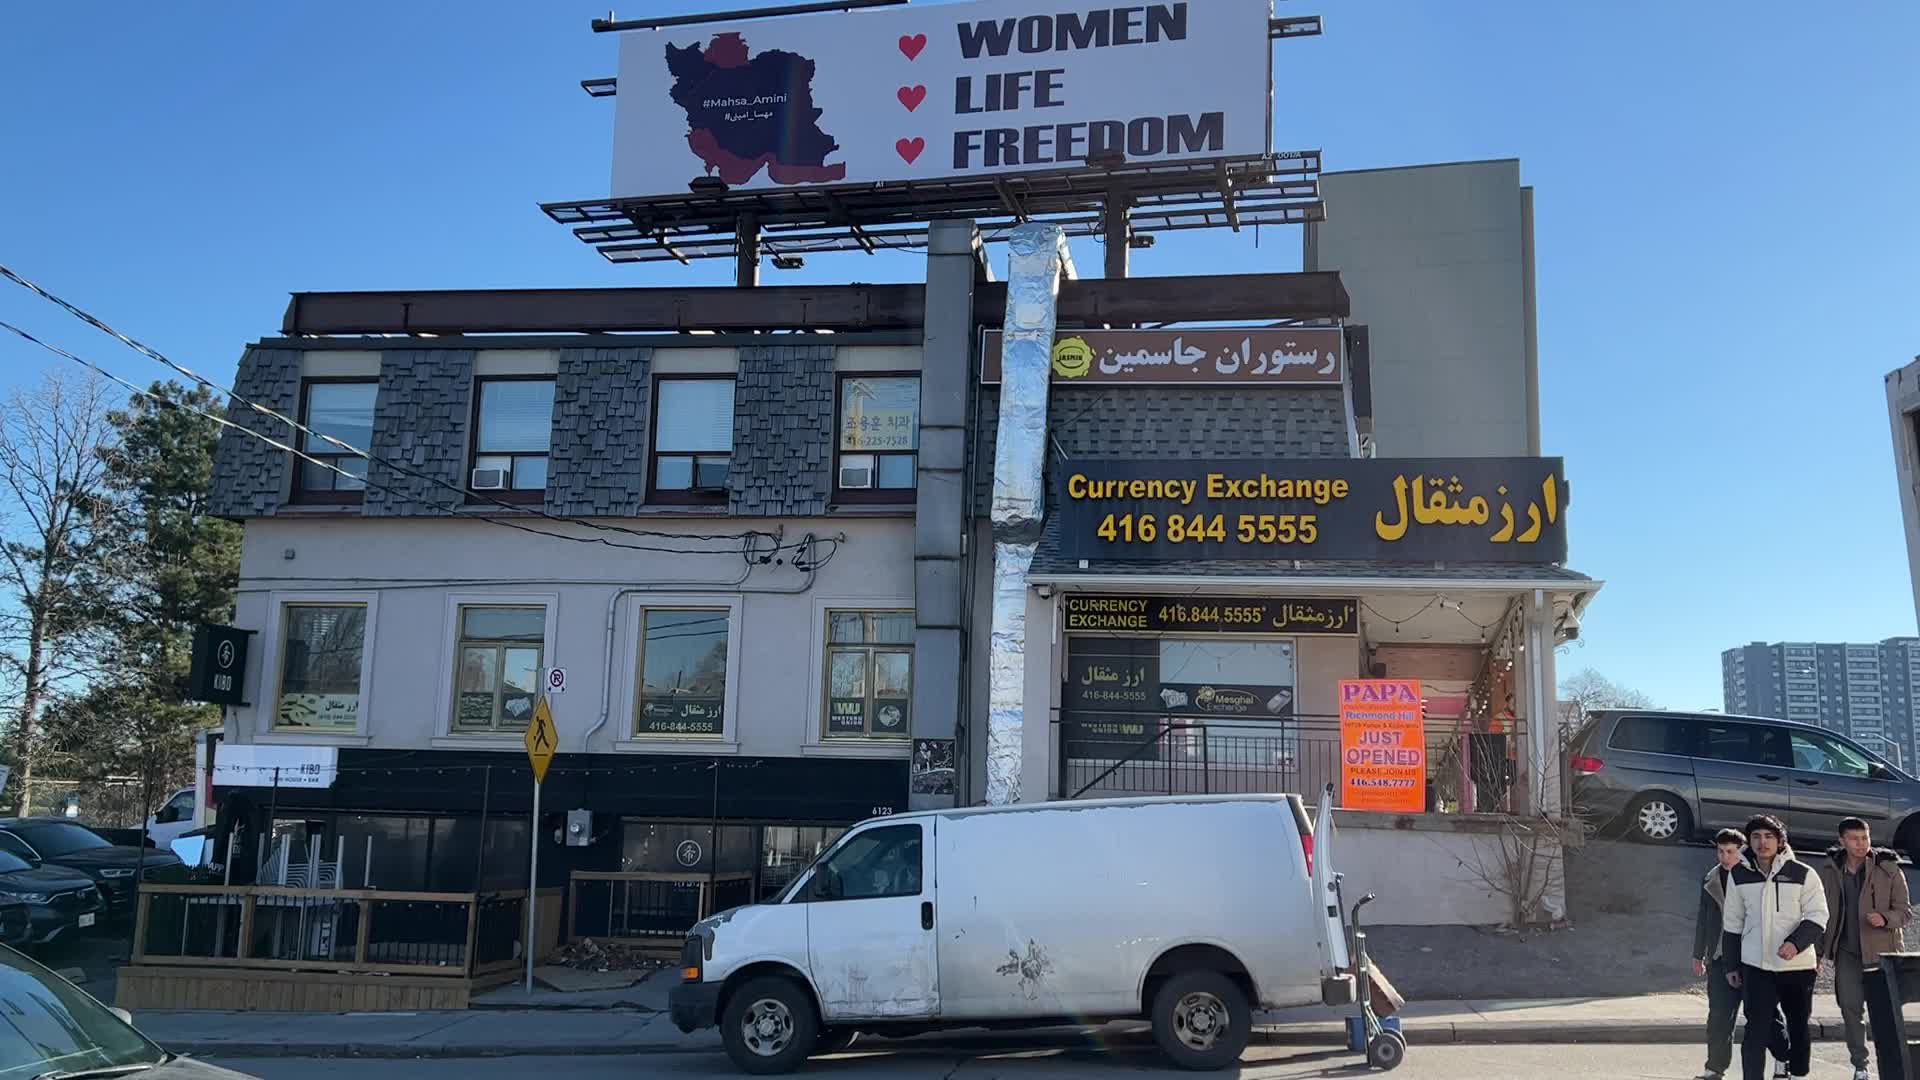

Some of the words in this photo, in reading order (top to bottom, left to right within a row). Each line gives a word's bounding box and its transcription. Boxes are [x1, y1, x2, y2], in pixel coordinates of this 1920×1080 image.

[957, 2, 1187, 59] WOMEN
[955, 68, 1065, 114] LIFE
[703, 93, 787, 108] #Mahsa_Amini
[953, 112, 1224, 169] FREEDOM
[1099, 336, 1206, 374] جاسمین
[1216, 337, 1335, 374] رستوران
[887, 416, 909, 431] 치과
[1068, 474, 1197, 504] Currency
[1207, 473, 1349, 504] Exchange
[1097, 514, 1156, 543] 416
[1167, 514, 1226, 543] 844
[1237, 515, 1317, 543] 5555
[1069, 600, 1148, 612] CURRENCY
[1069, 615, 1148, 627] EXCHANGE
[214, 674, 232, 691] KIBO
[1081, 666, 1118, 686] مثقال
[1122, 667, 1145, 687] ارز
[1082, 690, 1146, 701] 416-844-5555
[1215, 695, 1254, 705] Mesghal
[1344, 685, 1416, 702] PAPA
[1344, 711, 1396, 720] Richmond
[1399, 711, 1415, 720] Hill
[649, 722, 713, 732] 416-844-5555
[1360, 732, 1402, 745] JUST
[1346, 748, 1420, 765] OPENED
[300, 764, 320, 775] KIBO
[1350, 767, 1380, 775] PLEASE
[1384, 768, 1402, 776] JOIN
[872, 807, 893, 815] 6123
